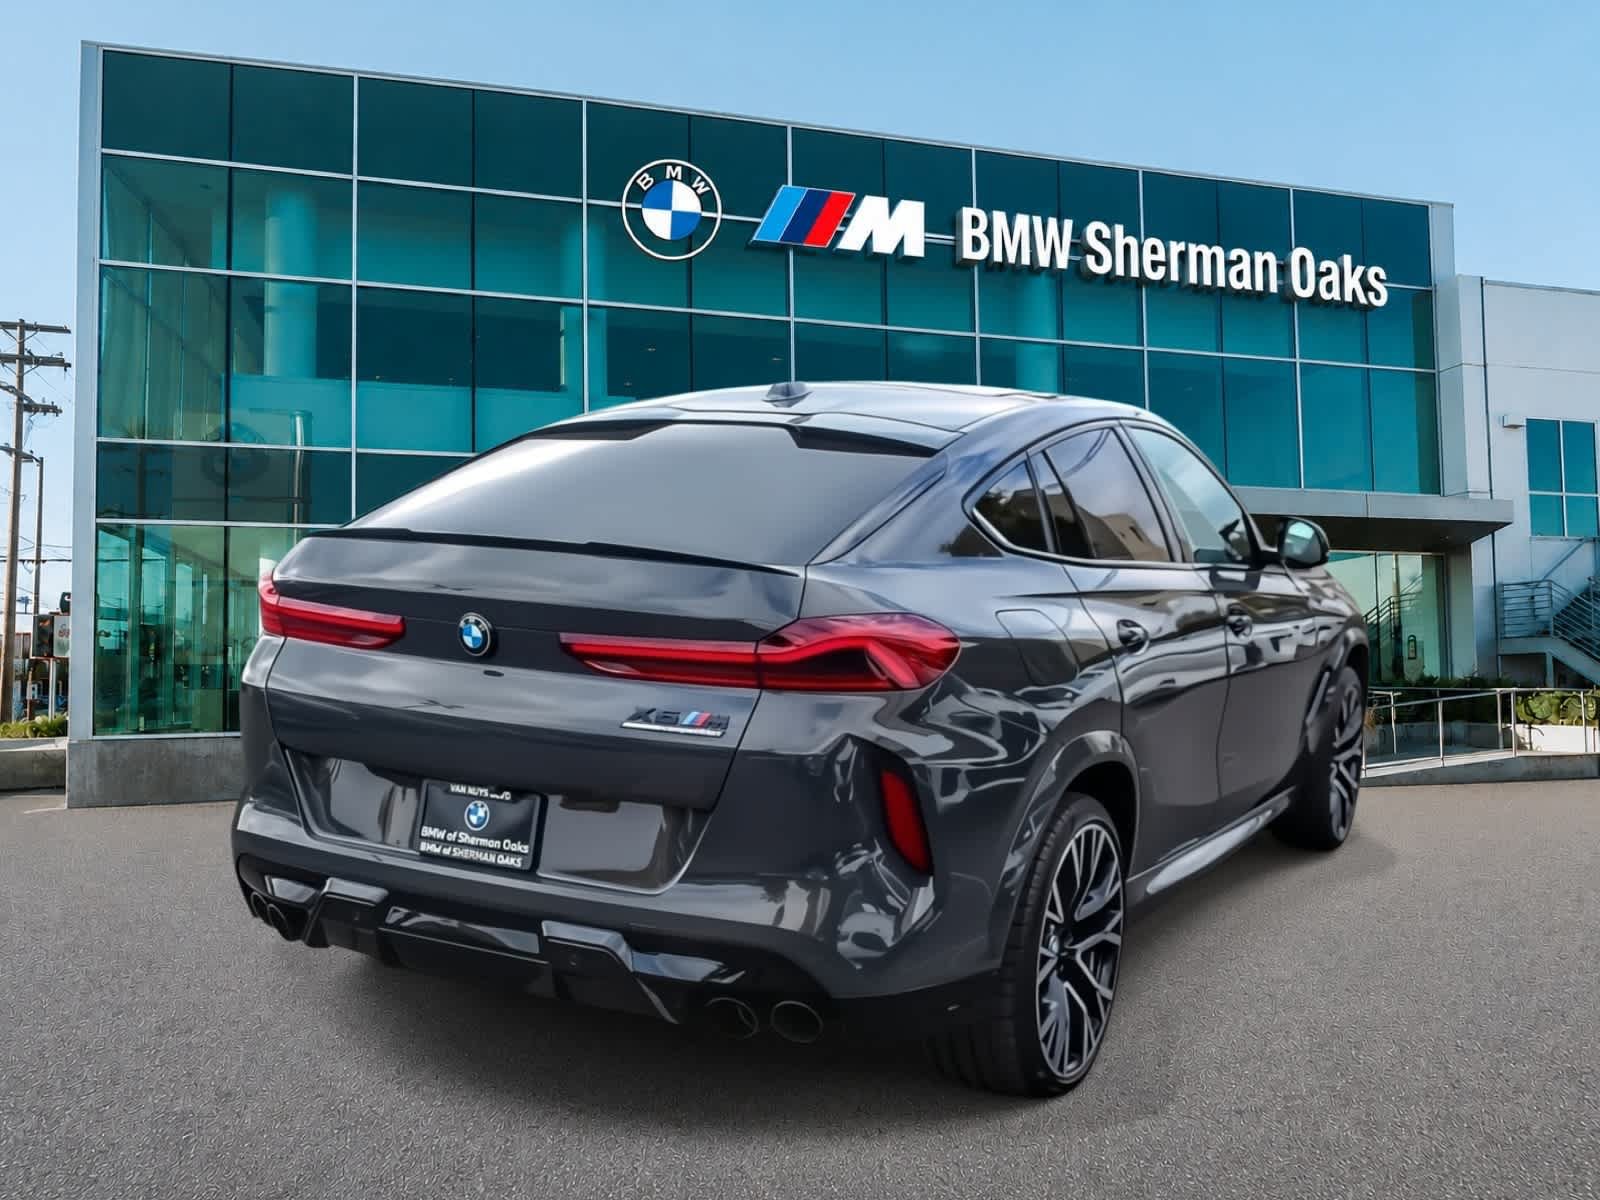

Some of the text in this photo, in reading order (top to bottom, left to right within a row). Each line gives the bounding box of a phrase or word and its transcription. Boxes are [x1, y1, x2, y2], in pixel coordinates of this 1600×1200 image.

[636, 164, 711, 196] BMW
[836, 194, 926, 258] M
[961, 207, 1389, 308] BMW Sherman Oaks
[450, 783, 466, 795] VAN
[419, 841, 442, 853] BMW
[452, 847, 497, 864] SHERMAN
[496, 854, 523, 868] OAKS
[420, 825, 529, 854] BMW of Sherman Oaks
